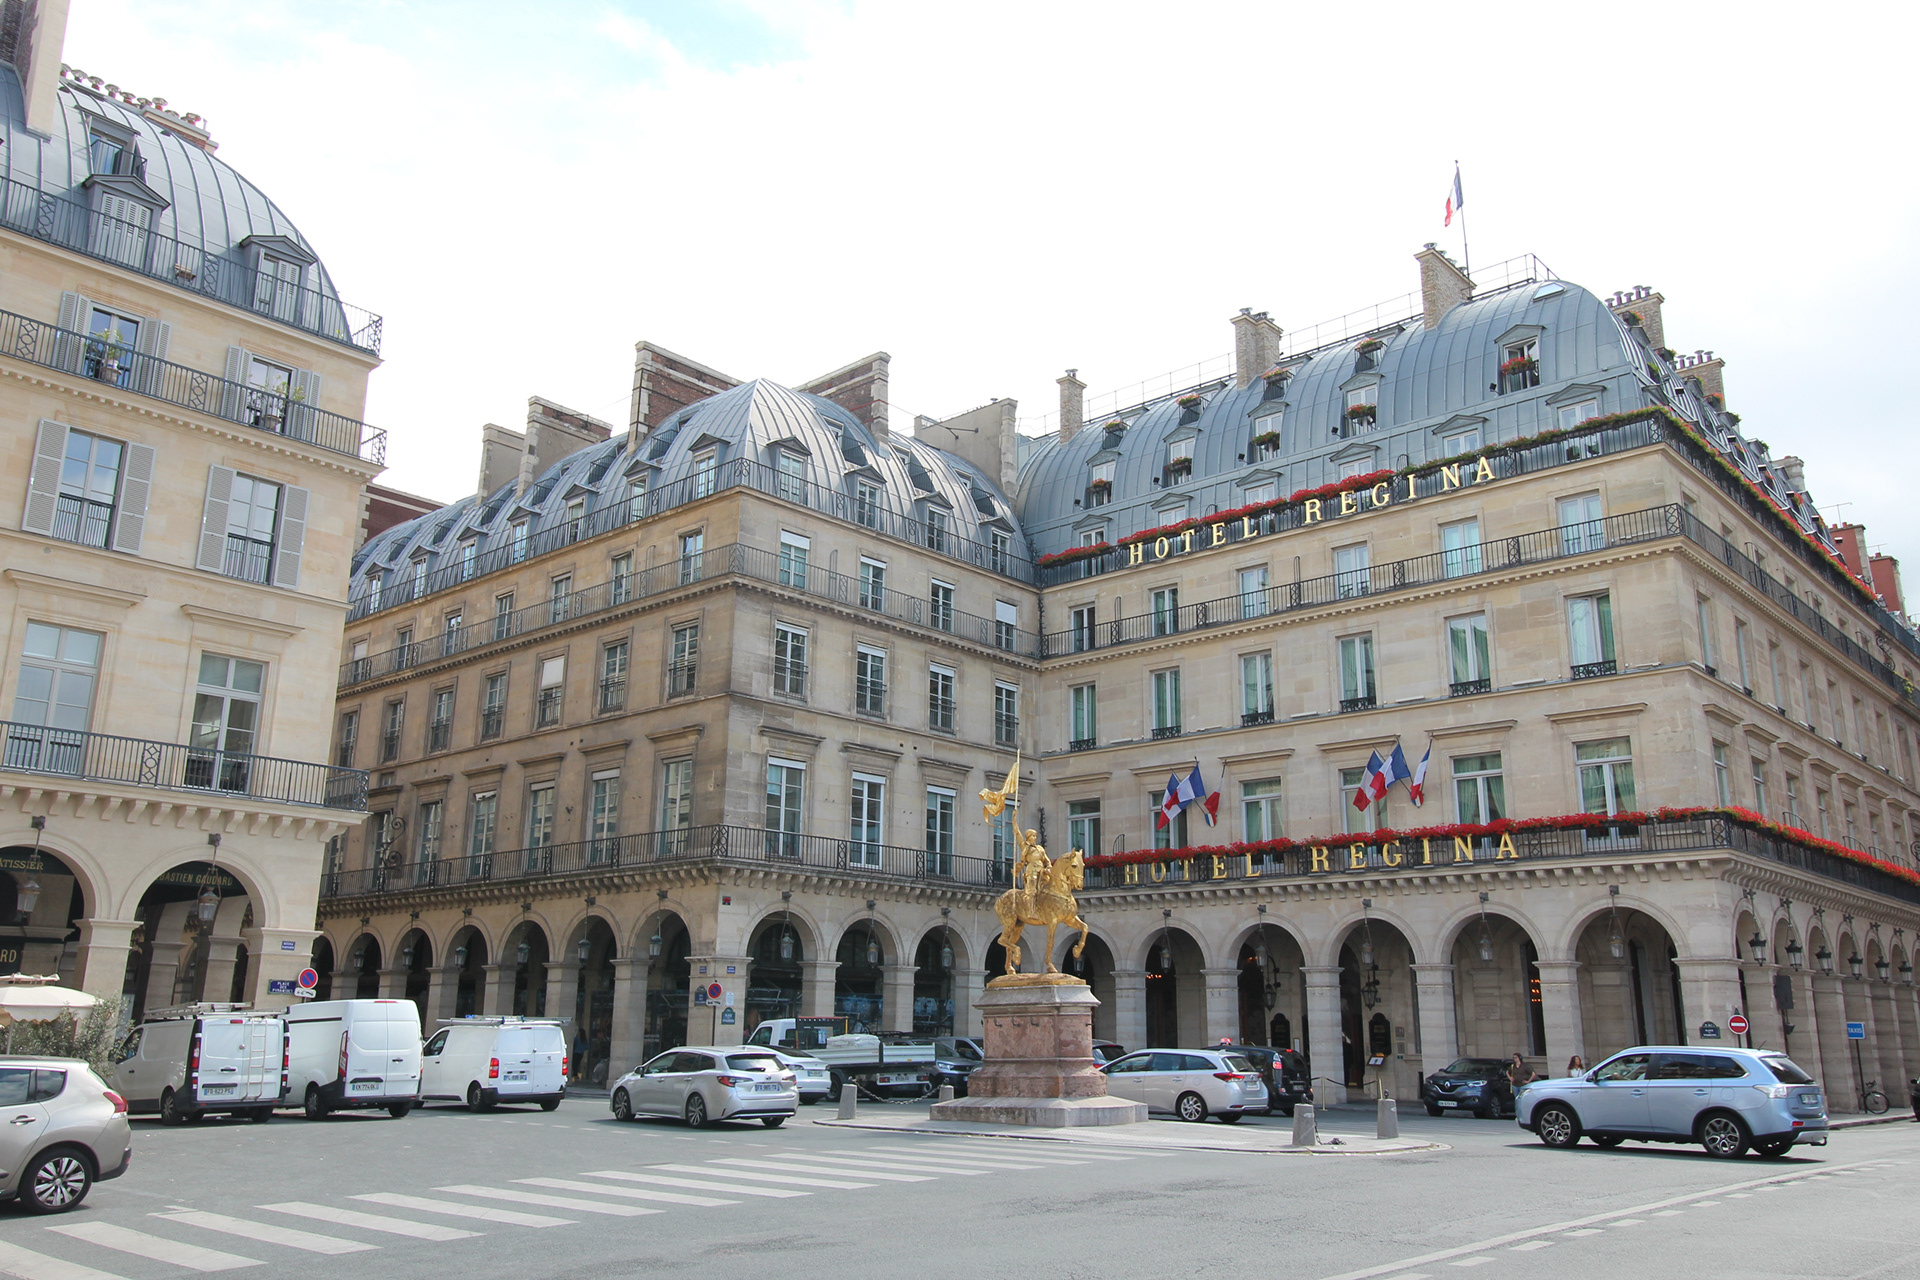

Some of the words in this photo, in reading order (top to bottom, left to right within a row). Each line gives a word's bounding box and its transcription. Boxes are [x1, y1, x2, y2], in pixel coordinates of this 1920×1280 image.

[1128, 515, 1258, 566] HOTEL
[1303, 456, 1496, 524] REGINA
[195, 873, 233, 886] GAUDARD
[1124, 852, 1262, 885] HOTEL
[1311, 831, 1519, 873] REGINA
